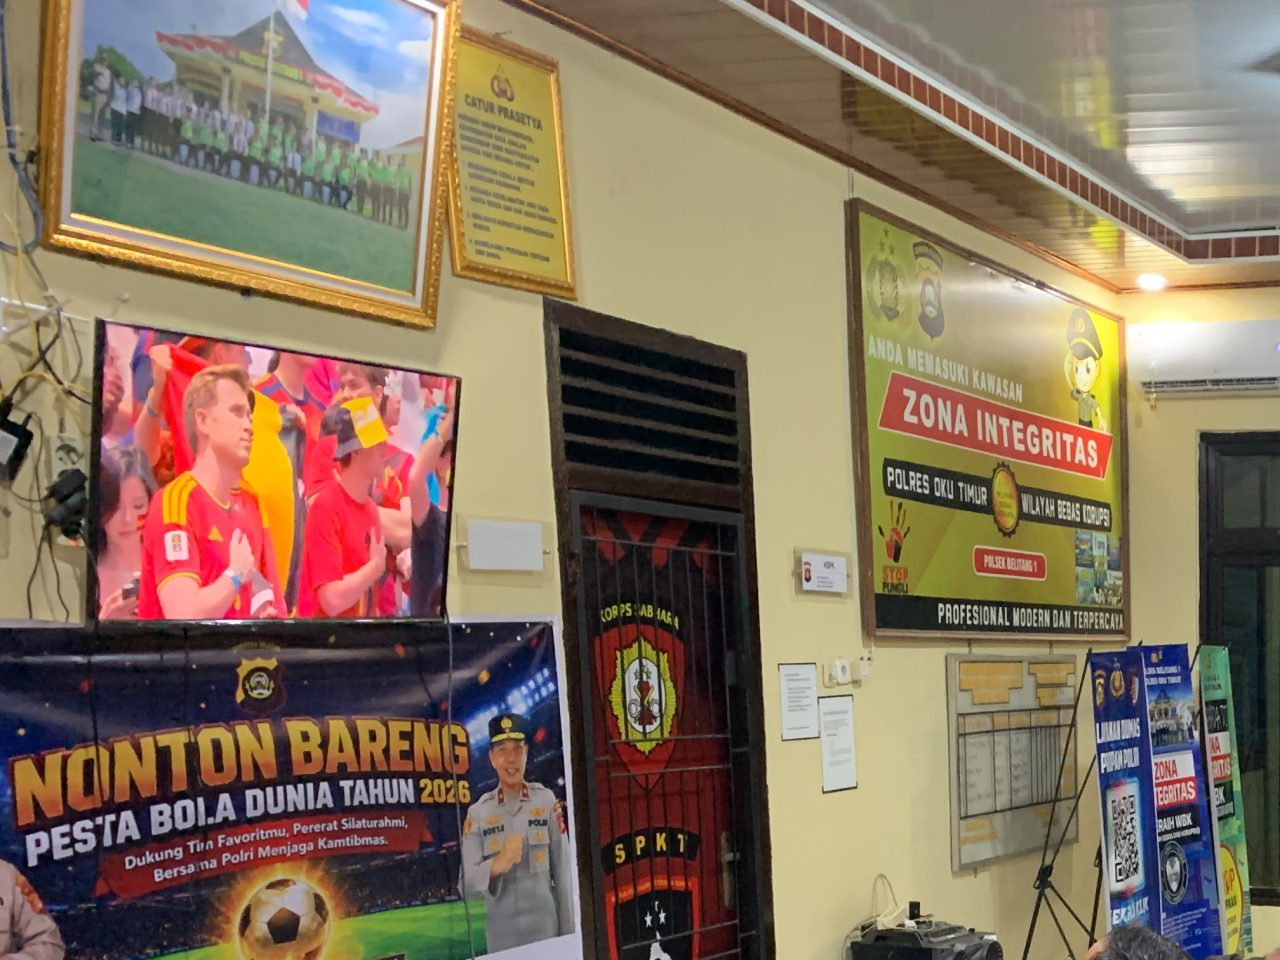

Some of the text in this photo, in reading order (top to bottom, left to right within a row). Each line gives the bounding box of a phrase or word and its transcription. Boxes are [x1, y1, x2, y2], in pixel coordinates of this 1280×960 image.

[464, 93, 543, 131] CATUR PRASETYA
[868, 335, 1023, 403] ANDA MEMASUKI KAWASAN
[903, 388, 1098, 468] ZONA INTEGRITAS
[886, 466, 929, 494] POLRES
[934, 477, 954, 499] OKU
[958, 482, 988, 505] TIMUR
[1021, 493, 1055, 517] WILAYAH
[1057, 499, 1081, 522] BEBAS
[1083, 504, 1110, 527] KORUPSI
[882, 567, 908, 582] STOP
[984, 554, 1005, 569] POLSEK
[1006, 557, 1033, 572] BELITANG
[882, 580, 908, 594] PUNGLI
[634, 603, 679, 630] ABHARA
[937, 602, 1124, 630] PROFESIONAL MODERN DAN TERPERCAYA
[13, 717, 470, 827] NONTON BARENG
[1154, 760, 1178, 781] ZONA
[25, 778, 471, 867] PESTA BOLA DUNIA TAHUN 2026
[1175, 813, 1193, 828] WBK
[124, 816, 409, 870] Dukung Tim Favoritmu, Pererat Silaturahmi,
[153, 834, 388, 882] Bersama Polri Menjaga Kamtibmas.
